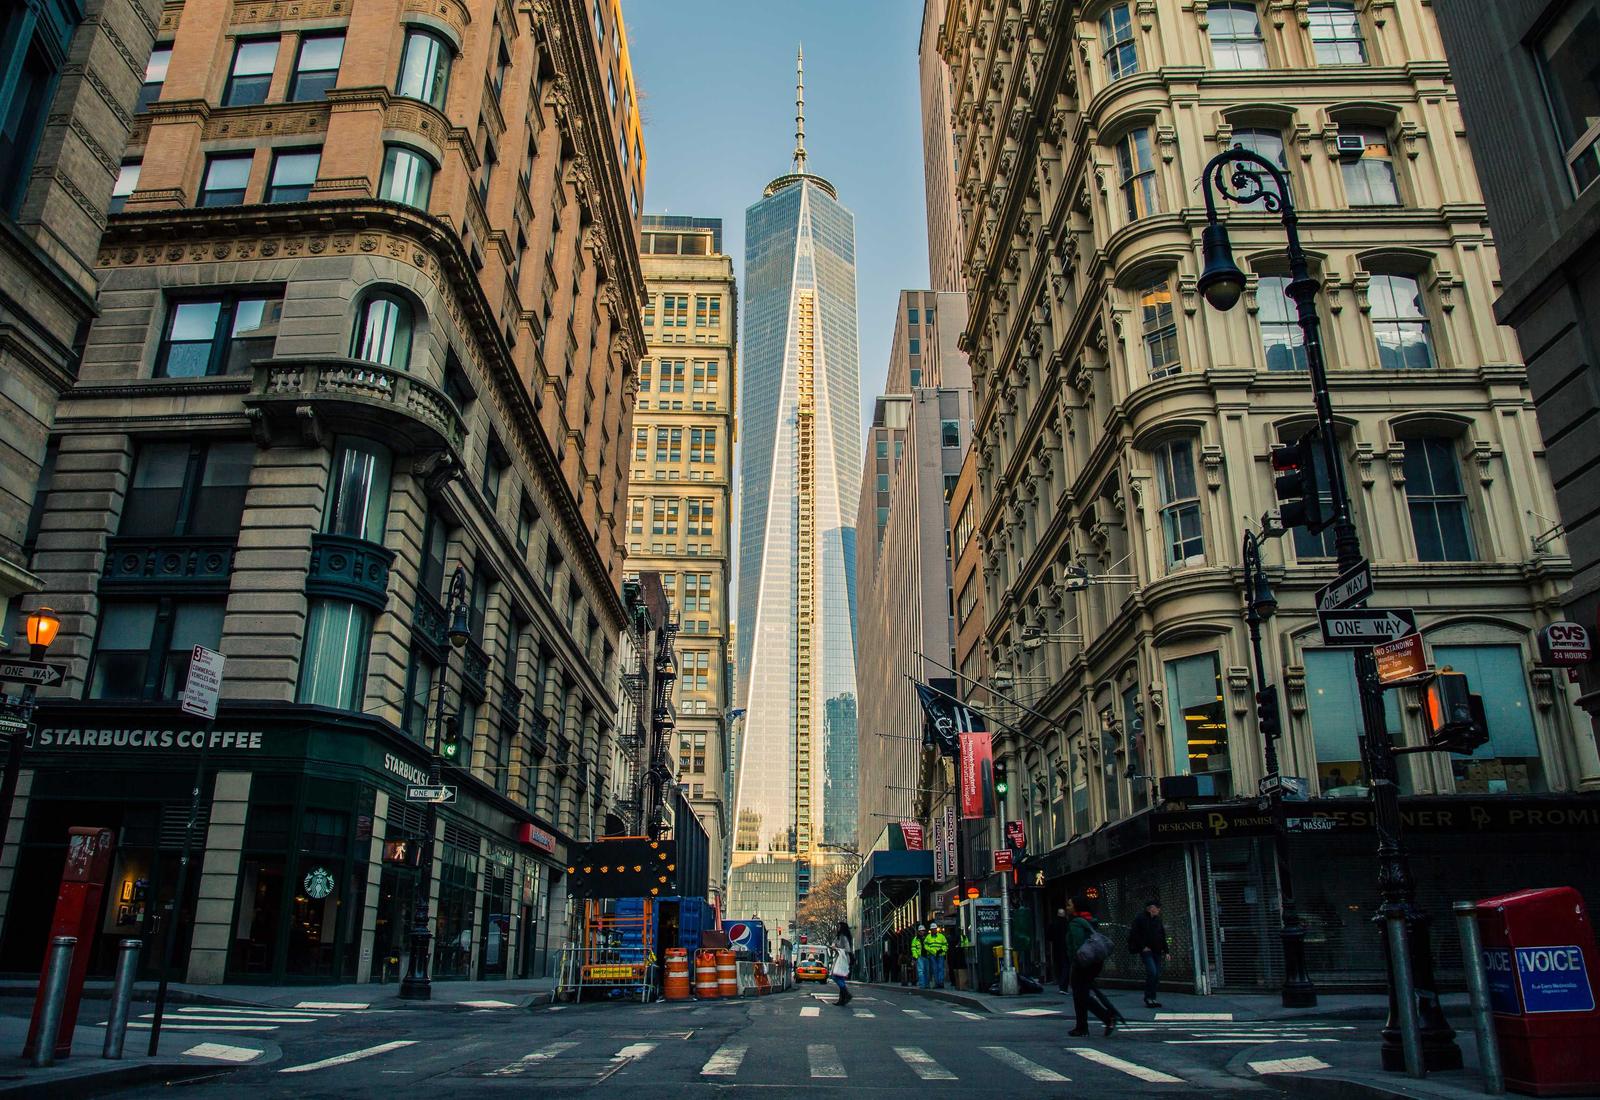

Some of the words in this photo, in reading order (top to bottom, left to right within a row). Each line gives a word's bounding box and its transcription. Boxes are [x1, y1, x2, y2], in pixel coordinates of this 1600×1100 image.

[1324, 591, 1341, 609] ONE
[1346, 574, 1363, 597] WAY
[1335, 621, 1363, 635] ONE
[1373, 620, 1401, 635] WAY
[1550, 626, 1585, 640] CVS
[194, 647, 202, 660] 3
[1376, 648, 1385, 656] NO
[1385, 639, 1414, 654] STANDING
[4, 666, 24, 677] ONE
[32, 669, 54, 680] WAY
[192, 664, 216, 678] COMMERCIAL
[191, 672, 209, 682] VEHICLES
[209, 677, 219, 685] ONLY
[39, 728, 174, 748] STARBUCKS
[176, 730, 264, 749] COFFEE
[384, 752, 426, 786] STARBUCKS
[1302, 821, 1332, 830] NASSAU
[1312, 810, 1453, 827] ESINER
[1157, 821, 1204, 833] DESIGNER
[1523, 949, 1581, 972] VOICE
